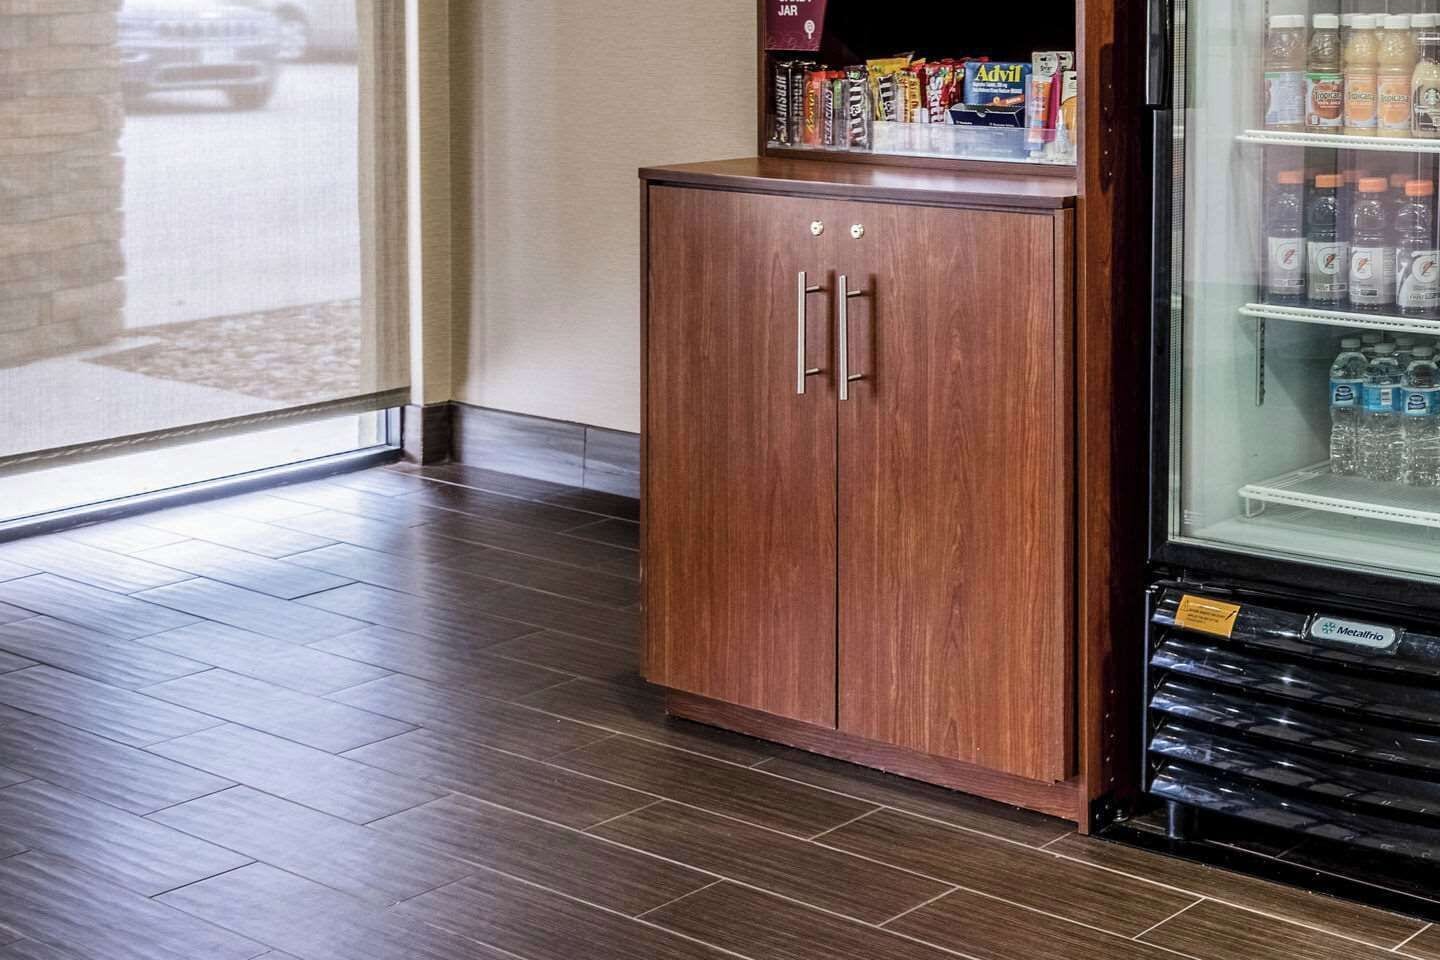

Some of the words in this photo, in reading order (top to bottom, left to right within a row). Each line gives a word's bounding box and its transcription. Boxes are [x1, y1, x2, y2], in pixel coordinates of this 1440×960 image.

[777, 5, 798, 17] JAR
[974, 64, 1023, 83] Advil
[1335, 626, 1384, 642] Metalfrio
